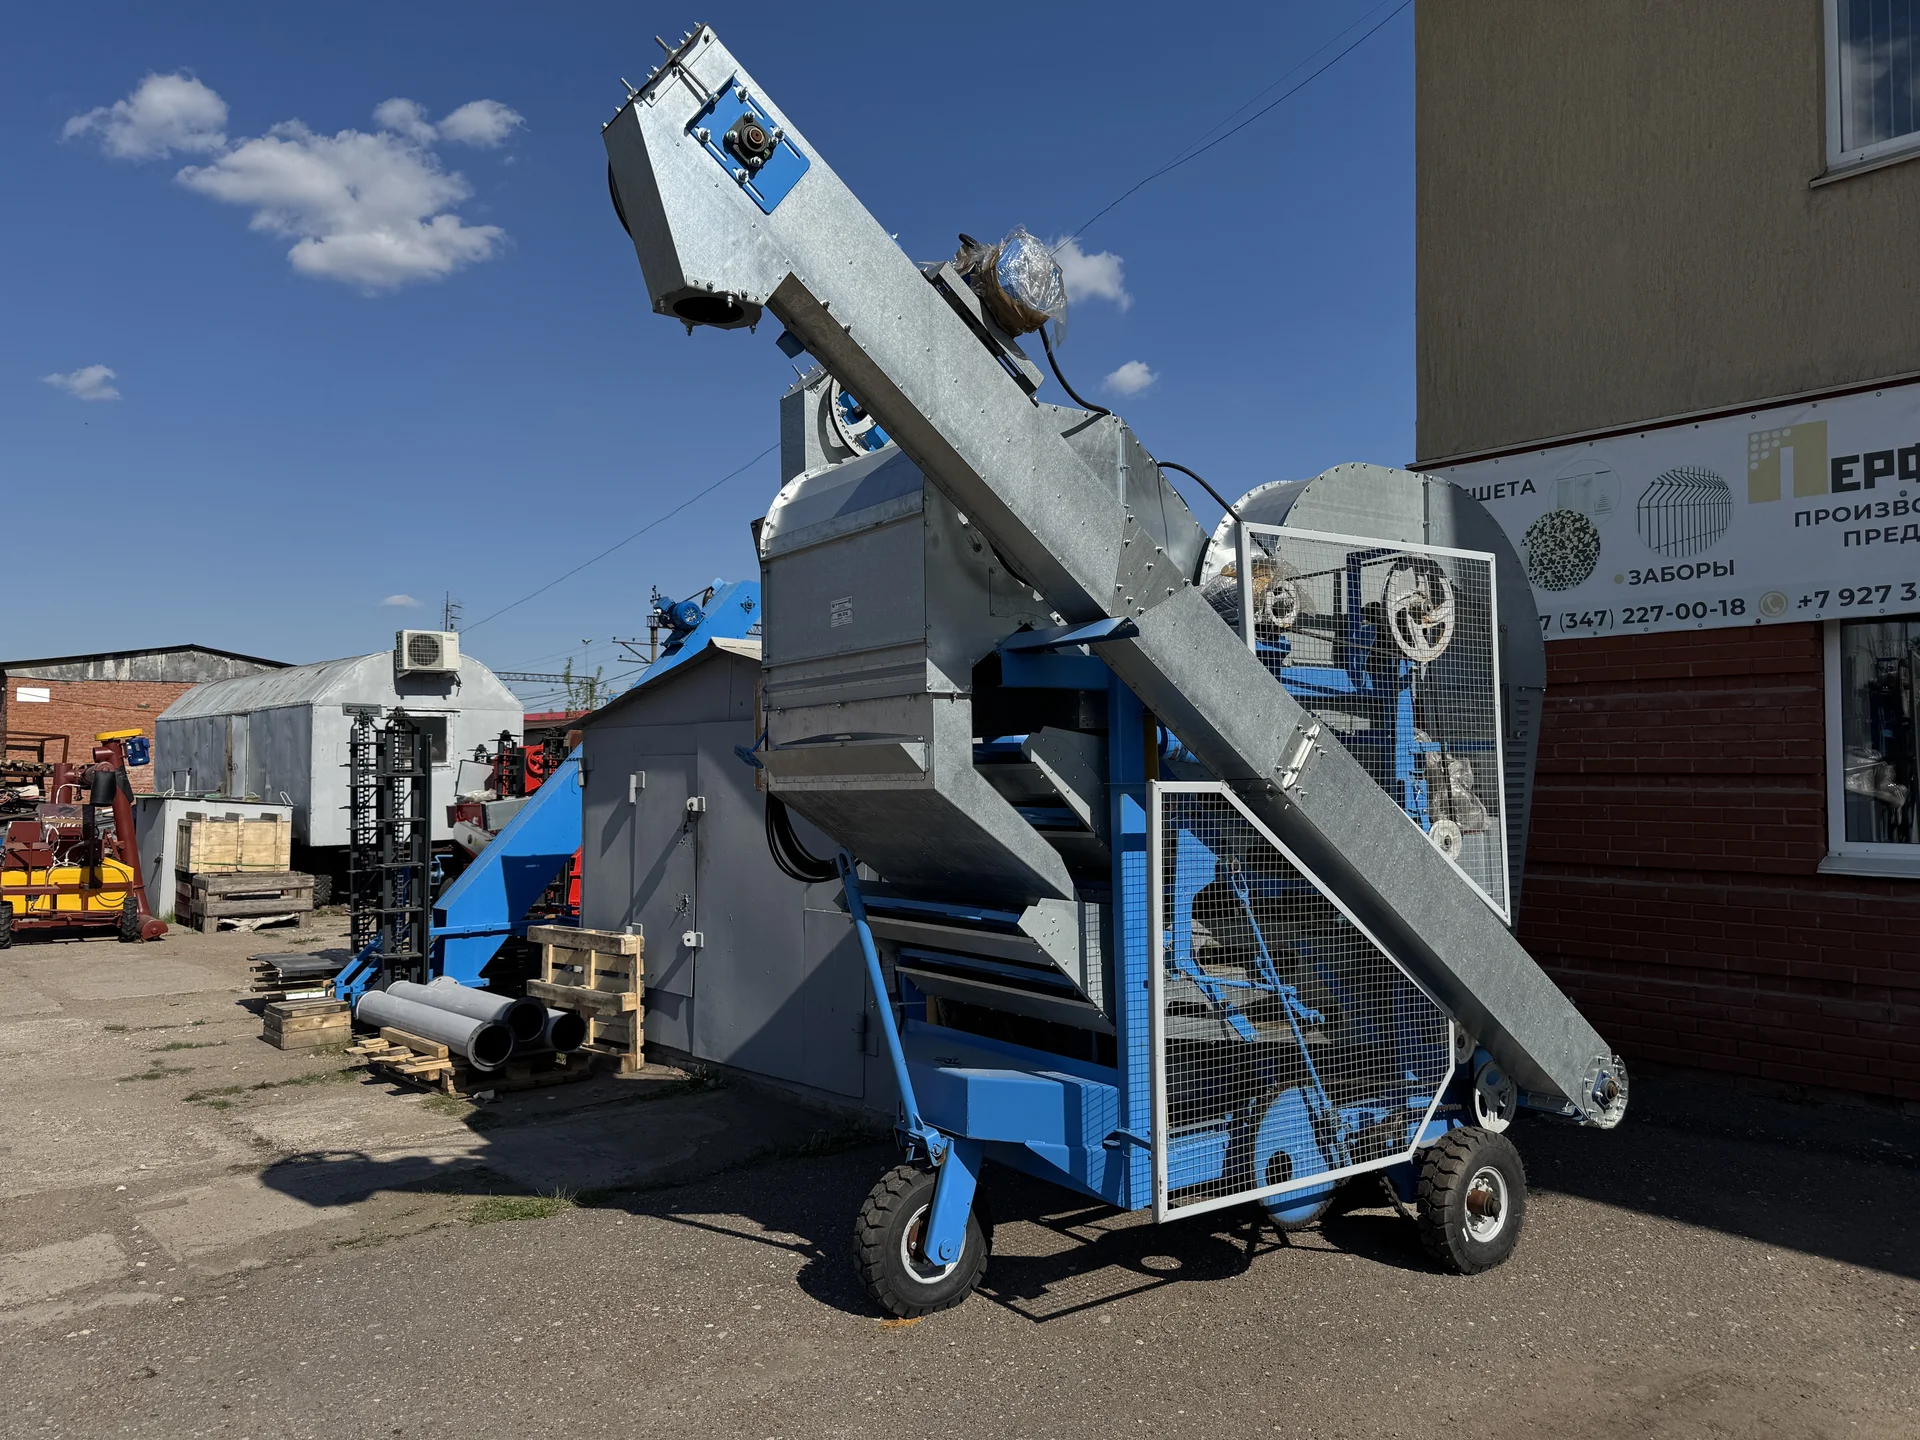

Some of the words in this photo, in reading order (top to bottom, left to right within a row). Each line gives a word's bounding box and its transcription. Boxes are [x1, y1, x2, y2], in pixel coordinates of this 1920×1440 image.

[1463, 478, 1536, 502] ШЕТА
[1628, 559, 1735, 585] ЗАБОРЫ
[1799, 590, 1830, 609] +7
[1838, 584, 1892, 607] 927
[1900, 582, 1920, 601] 3
[1559, 609, 1614, 633] (347)
[1622, 598, 1746, 624] 227-00-18
